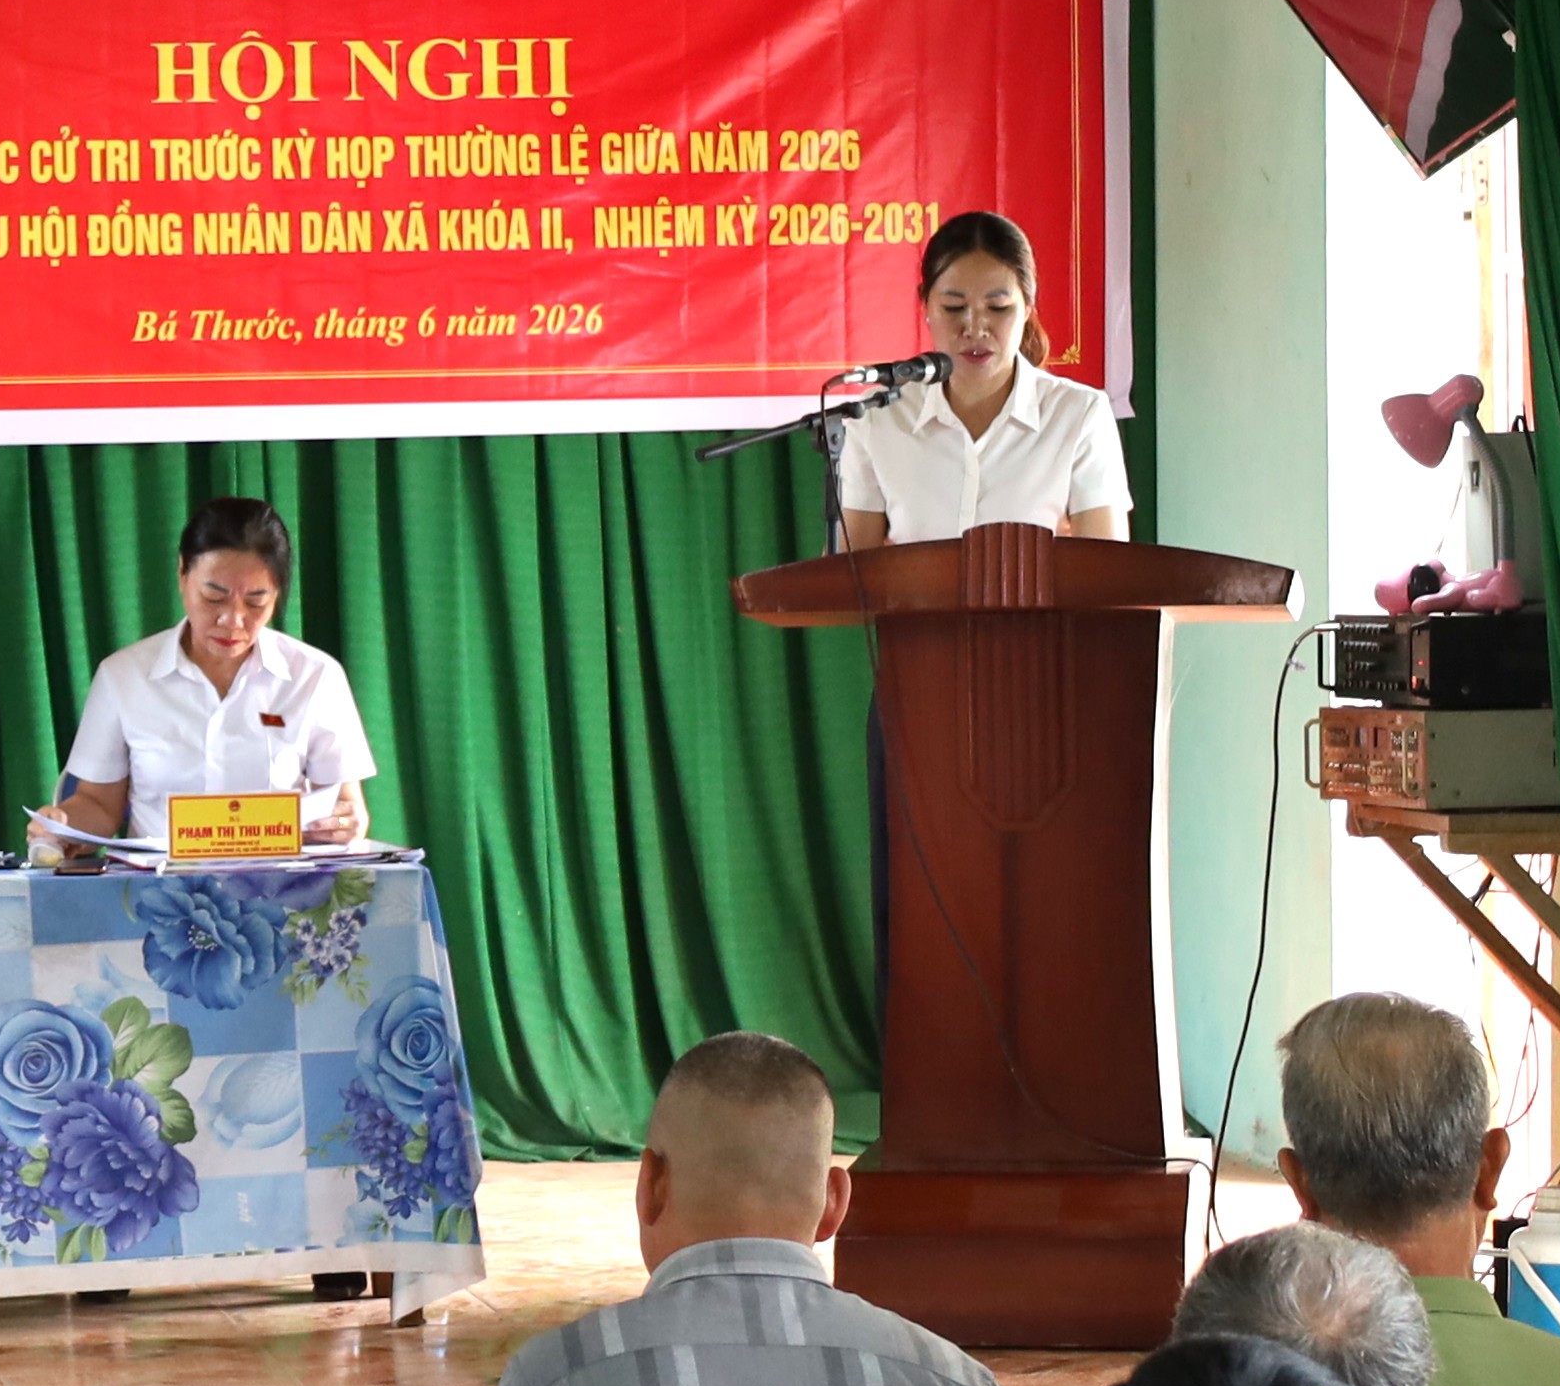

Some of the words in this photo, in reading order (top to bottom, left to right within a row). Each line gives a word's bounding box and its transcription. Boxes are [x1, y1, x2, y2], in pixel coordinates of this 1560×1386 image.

[151, 29, 319, 121] HỘI
[343, 37, 573, 116] NGHỊ
[30, 125, 81, 184] CỬ
[85, 139, 140, 183] TRI
[149, 128, 262, 182] TRƯỚC
[271, 127, 316, 180] KỲ
[326, 134, 395, 189] HỌP
[404, 124, 541, 179] THƯỜNG
[551, 124, 590, 185] LỆ
[600, 123, 680, 176] GIỮA
[690, 121, 769, 173] NĂM
[779, 127, 861, 173] 2026
[19, 205, 78, 267] HỘI
[86, 199, 184, 258] ĐỒNG
[193, 201, 291, 256] NHÂN
[300, 201, 372, 254] DÂN
[382, 201, 430, 252] XÃ
[438, 199, 531, 252] KHÓA
[540, 207, 574, 256] II,
[594, 198, 706, 258] NHIỆM
[716, 195, 760, 247] KỲ
[768, 200, 941, 247] 2026-2031
[132, 310, 178, 343] Bá
[190, 308, 303, 346] Thước,
[313, 306, 408, 348] tháng
[417, 306, 437, 338] 6
[445, 306, 518, 338] năm
[525, 303, 605, 338] 2026
[178, 825, 213, 841] PHẠM
[217, 825, 235, 840] THỊ
[239, 825, 261, 837] THU
